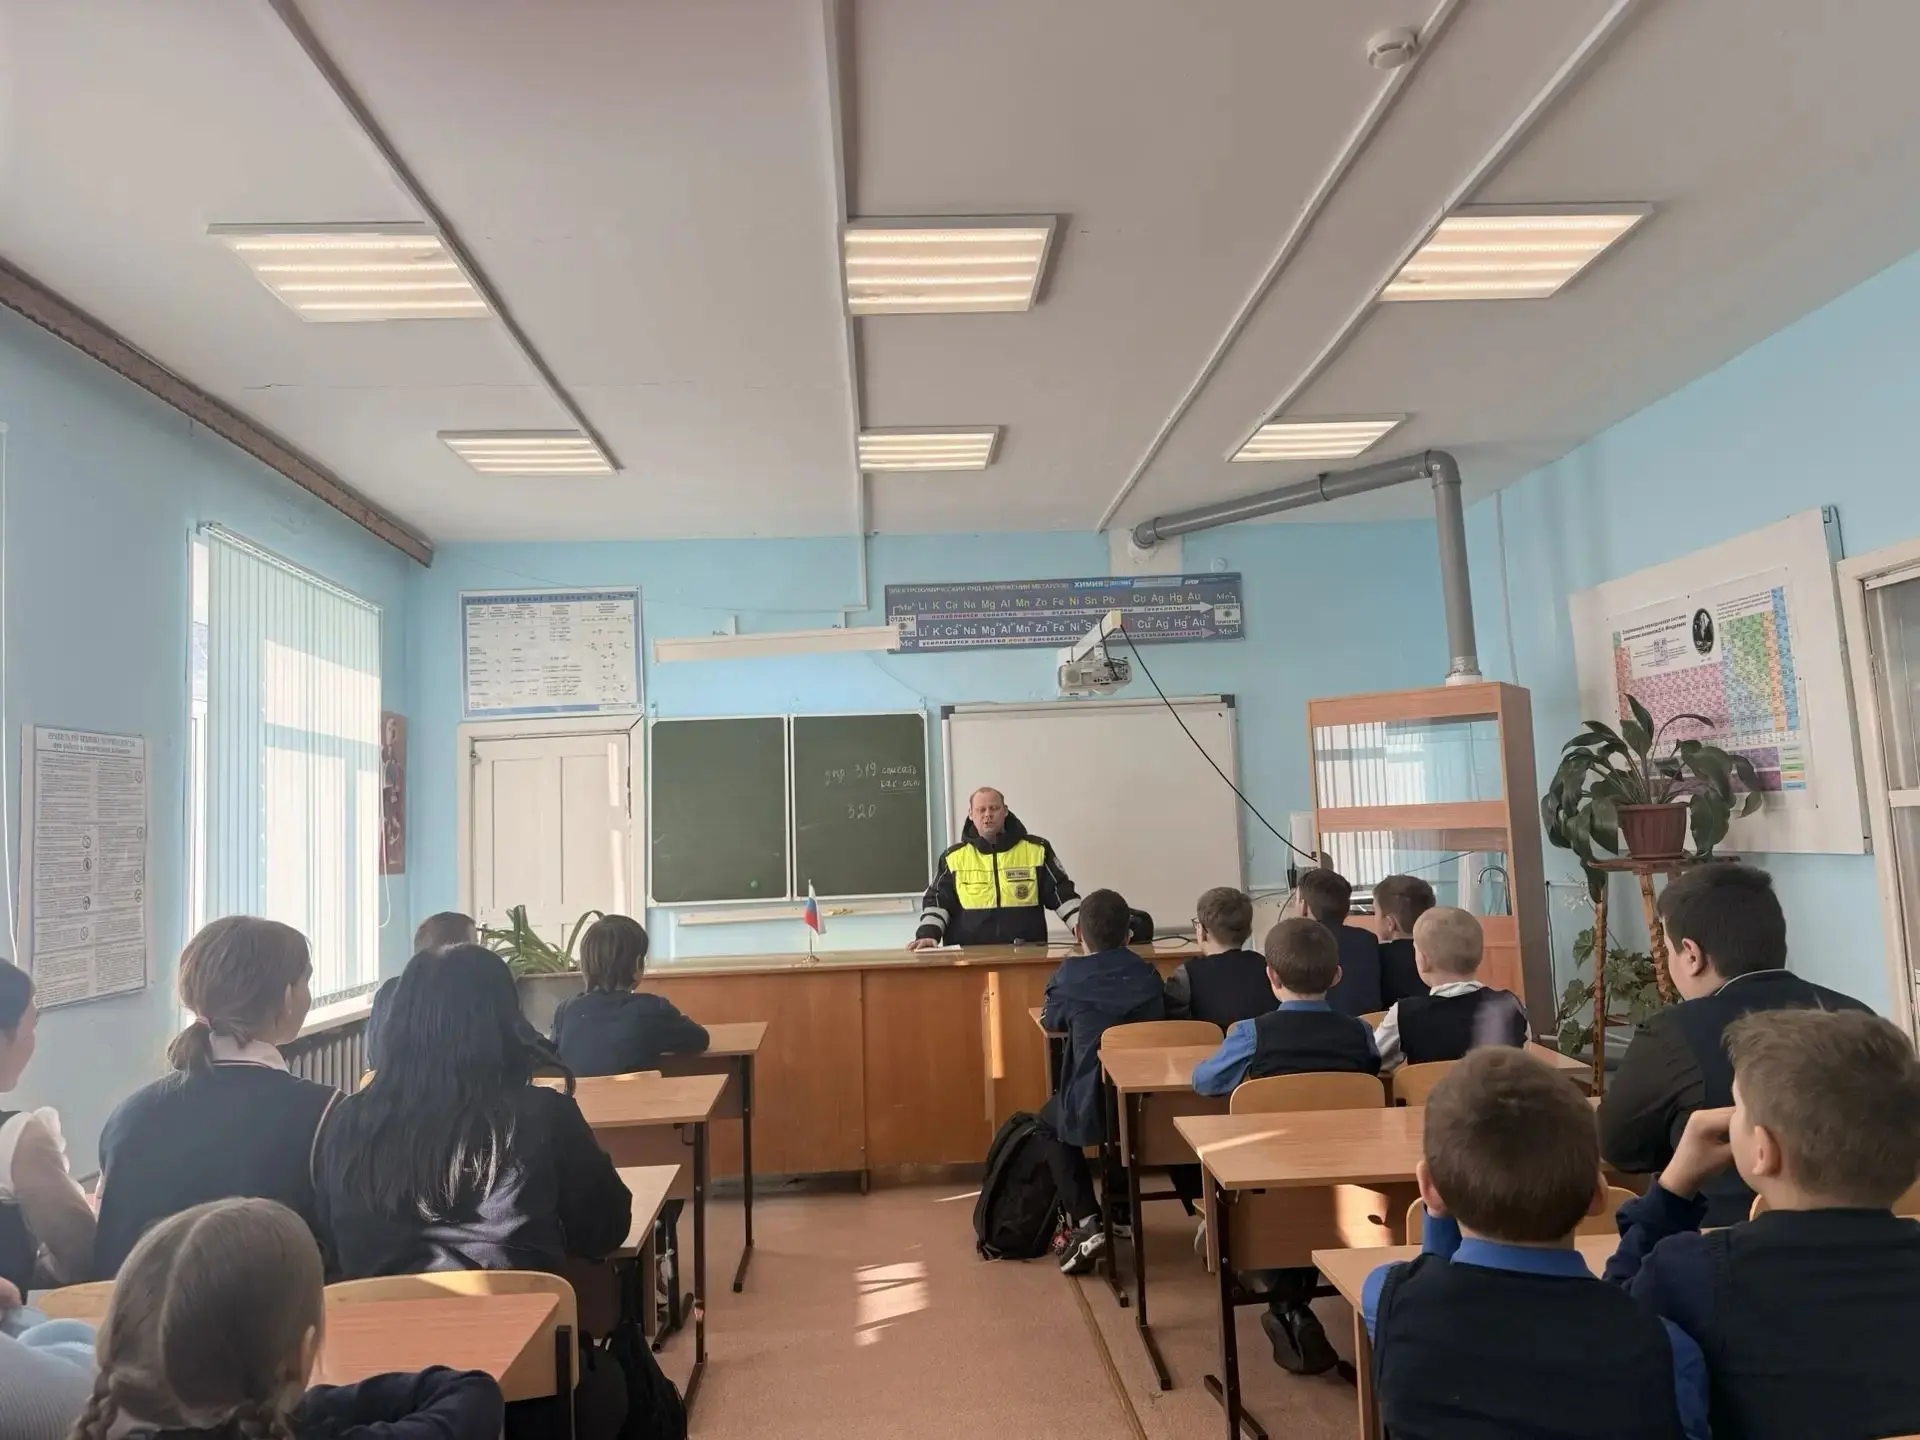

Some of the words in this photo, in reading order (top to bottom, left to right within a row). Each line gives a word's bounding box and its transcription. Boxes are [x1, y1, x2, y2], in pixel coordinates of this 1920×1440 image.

[1074, 580, 1104, 588] ХИМИЯ
[918, 601, 928, 610] Li
[932, 601, 940, 610] K
[945, 600, 958, 610] Ca
[963, 600, 976, 609] Na
[981, 599, 996, 610] Mg
[1000, 599, 1011, 608] Al
[1016, 598, 1030, 607] Mn
[1035, 598, 1047, 607] Zn
[1052, 597, 1064, 606] Fe
[1069, 596, 1080, 606] Ni
[1084, 596, 1097, 605] Sn
[1102, 596, 1116, 604] Pb
[1132, 594, 1146, 603] Cu
[1151, 593, 1164, 604] Ag
[1169, 592, 1183, 603] Hg
[1187, 591, 1201, 601] Au
[846, 804, 877, 820] 320
